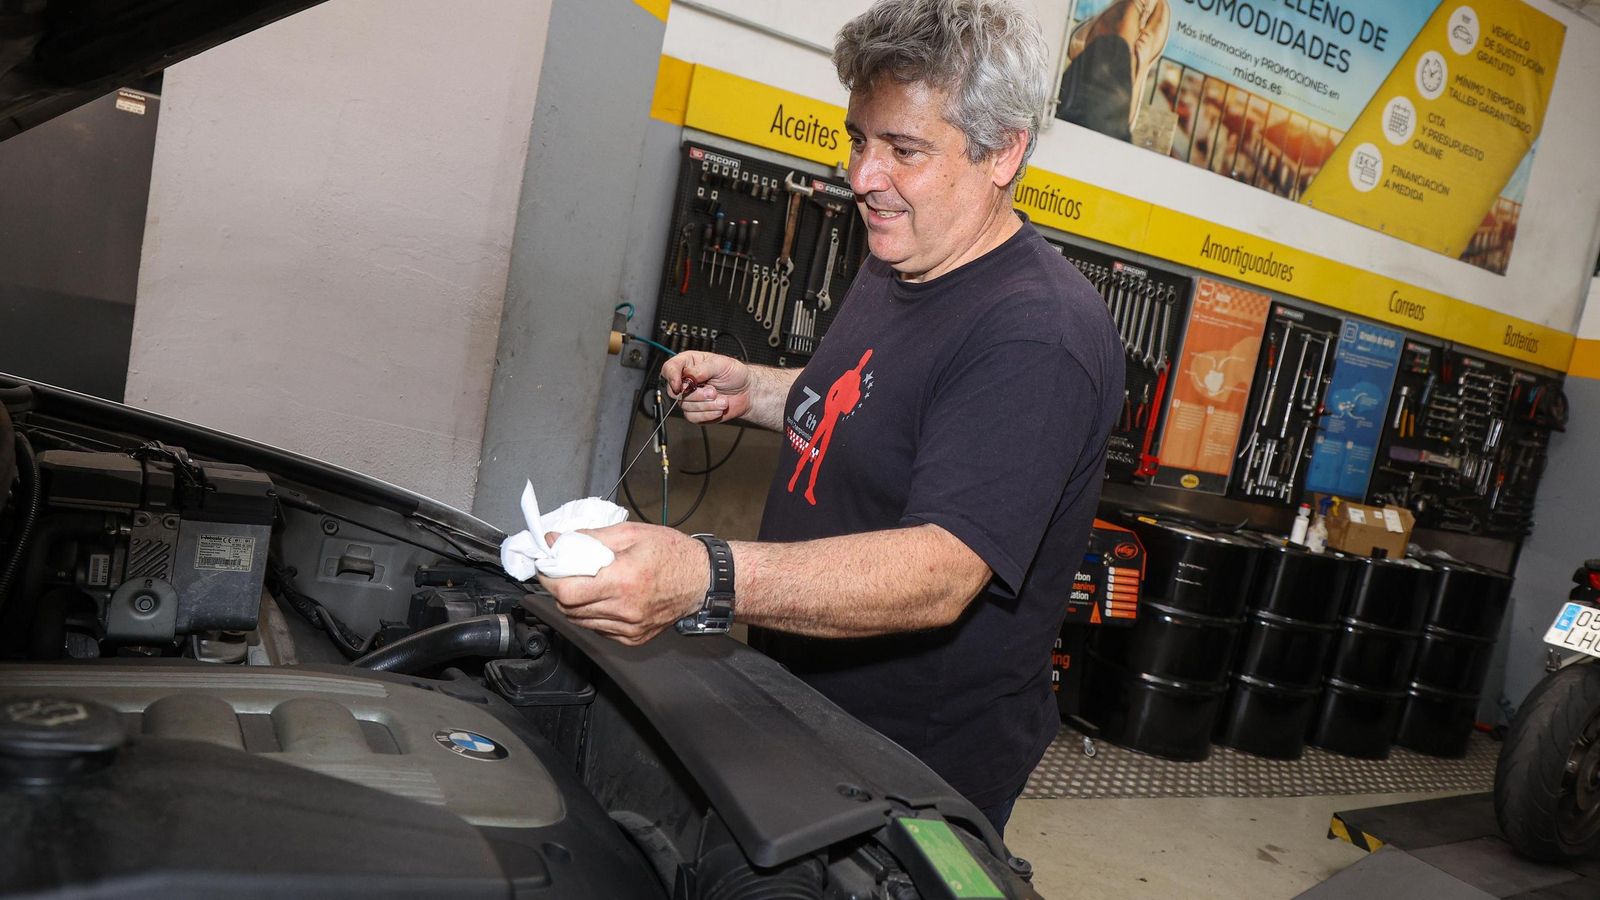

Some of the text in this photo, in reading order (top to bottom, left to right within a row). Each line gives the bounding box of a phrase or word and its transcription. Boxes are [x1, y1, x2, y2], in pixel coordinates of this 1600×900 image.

[1184, 0, 1352, 73] MODIDADES
[1358, 19, 1388, 52] DE
[1484, 37, 1495, 50] DE
[1177, 21, 1340, 100] Más información y PROMOCIONES en
[1476, 50, 1516, 77] GRATUITO
[1232, 65, 1283, 96] midas.es
[1455, 74, 1527, 115] MÍNIMO TIEMPO EN
[1428, 112, 1446, 128] CITA
[1449, 86, 1532, 134] TALLER GARANTIZADO
[770, 103, 839, 150] Aceites
[1413, 138, 1444, 160] ONLINE
[1421, 125, 1485, 161] Y PRESUPUESTO
[1384, 179, 1424, 202] A MEDIDA
[1391, 164, 1451, 196] FINANCIACIÓN
[1014, 183, 1083, 220] umáticos
[1200, 233, 1295, 283] Amortiguadores
[1388, 289, 1427, 322] Correas
[1503, 324, 1541, 354] Baterías
[1071, 582, 1096, 594] eaning
[1074, 571, 1091, 582] rbon
[1070, 591, 1089, 601] ation
